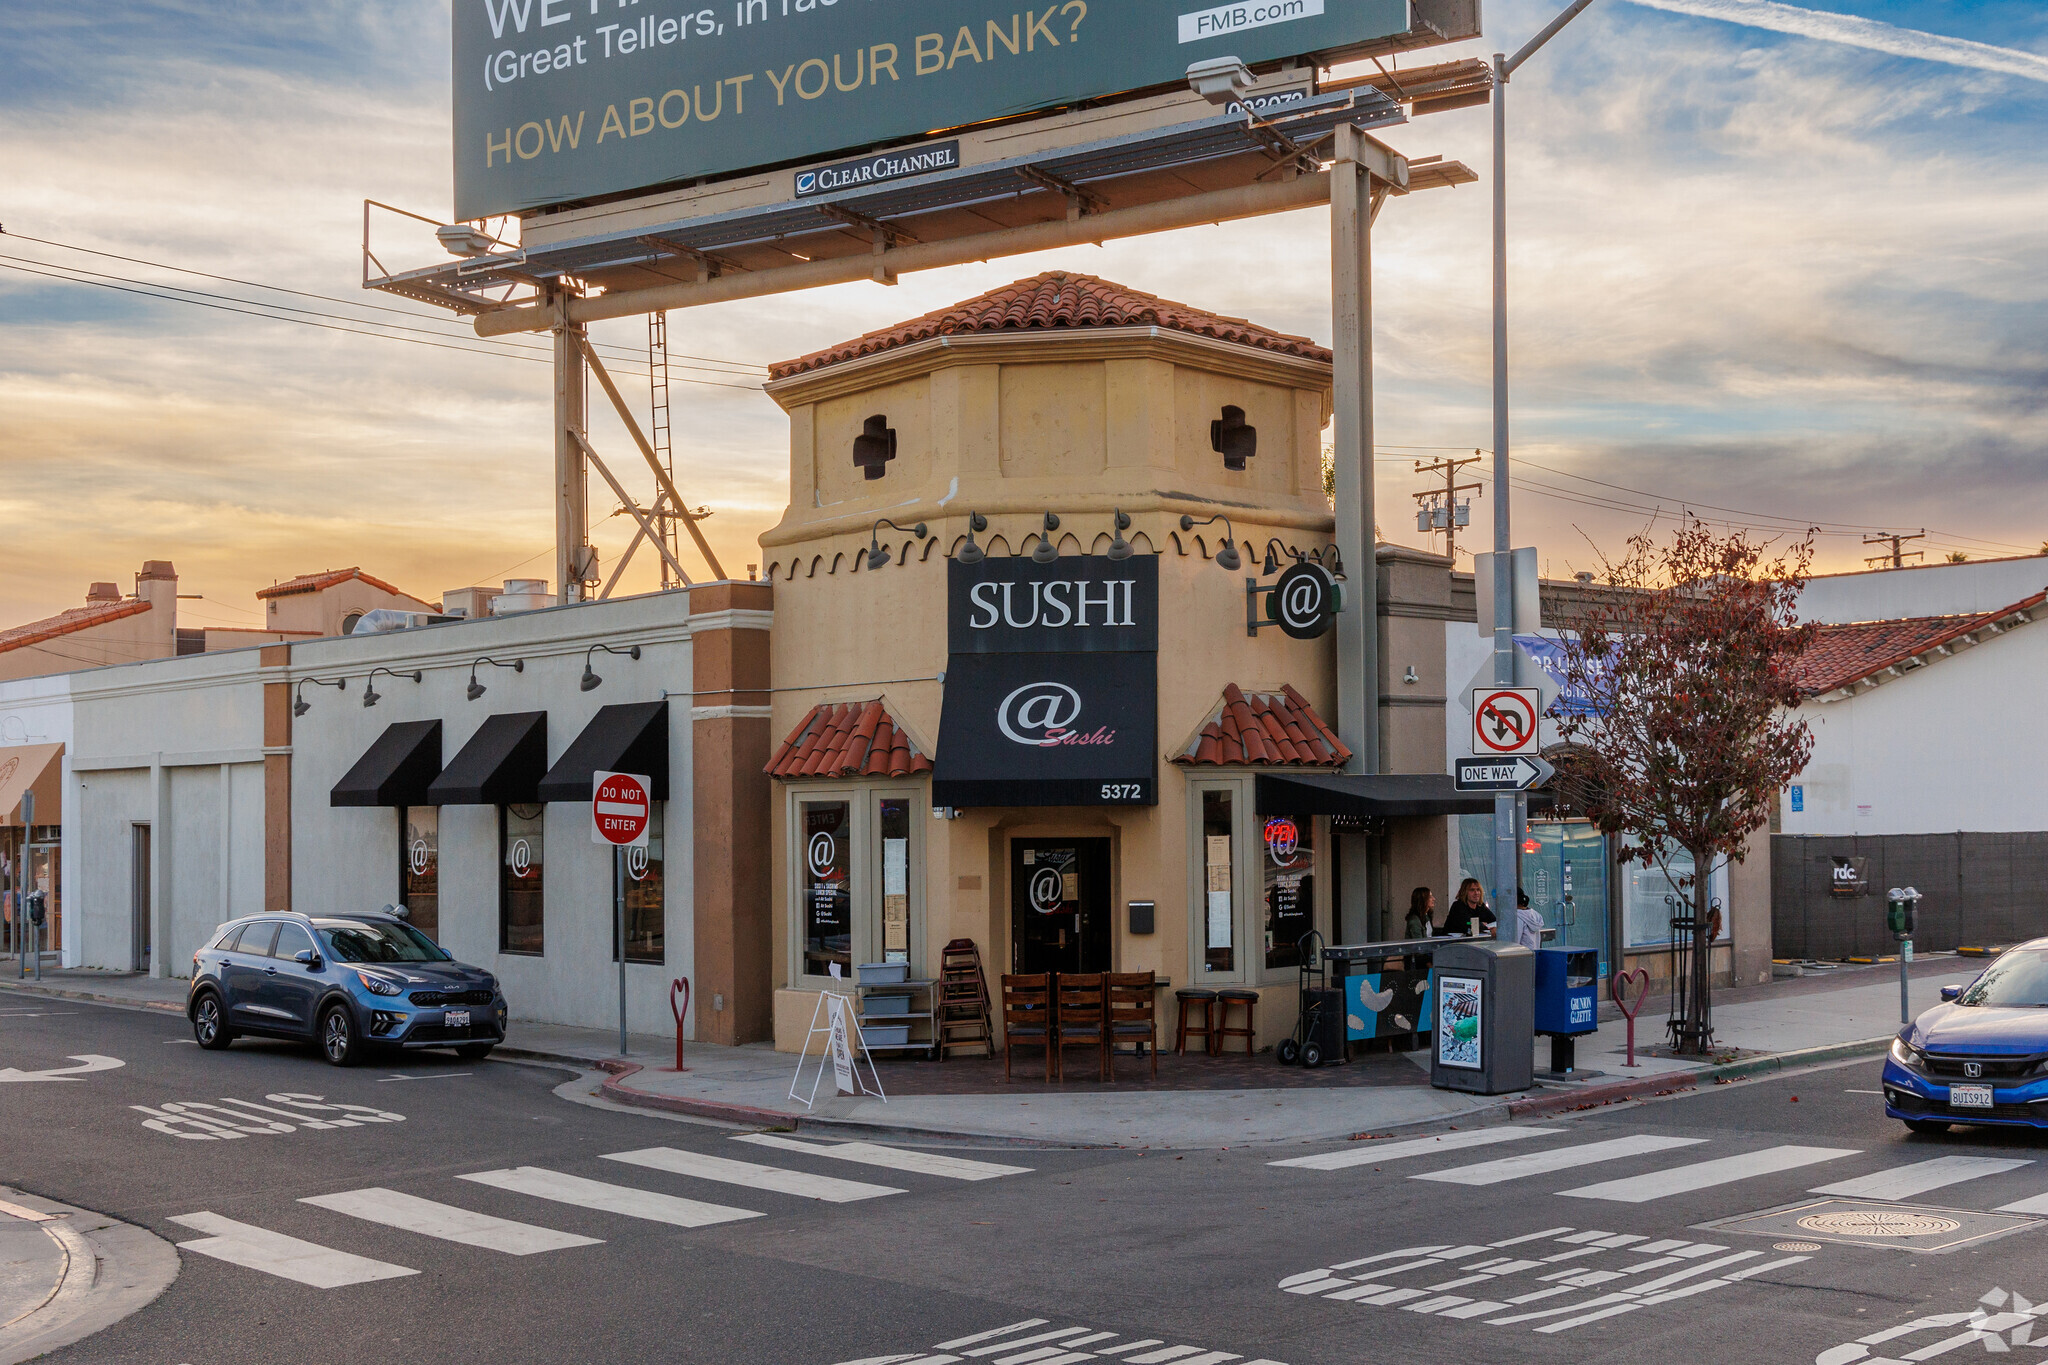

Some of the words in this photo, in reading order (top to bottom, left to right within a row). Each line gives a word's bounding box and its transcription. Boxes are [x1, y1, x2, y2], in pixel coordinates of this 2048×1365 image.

[1197, 0, 1304, 34] FMB.com
[484, 35, 587, 92] (Great
[596, 9, 724, 58] Tellers,
[486, 111, 586, 168] HOW
[596, 73, 754, 145] ABOUT
[765, 43, 900, 106] YOUR
[914, 1, 1088, 77] BANK?
[969, 580, 1137, 629] SUSHI
[1281, 574, 1322, 628] @
[1531, 655, 1553, 673] OR
[997, 681, 1082, 746] @
[1038, 725, 1117, 747] Sushi
[1464, 767, 1488, 780] ONE
[1491, 766, 1516, 779] WAY
[602, 786, 616, 799] DO
[621, 788, 641, 801] NOT
[1101, 783, 1142, 800] 5372
[604, 818, 637, 832] ENTER
[1264, 824, 1295, 842] OPEN
[411, 839, 428, 875] @
[511, 838, 531, 878] @
[808, 831, 835, 878] @
[1270, 819, 1299, 867] @
[627, 846, 649, 881] @
[1833, 863, 1857, 880] rdc.
[1029, 867, 1062, 914] @
[1570, 997, 1592, 1010] GRUNION
[1570, 1009, 1592, 1024] GAZETTE
[1952, 1092, 1990, 1105] 8UIS912
